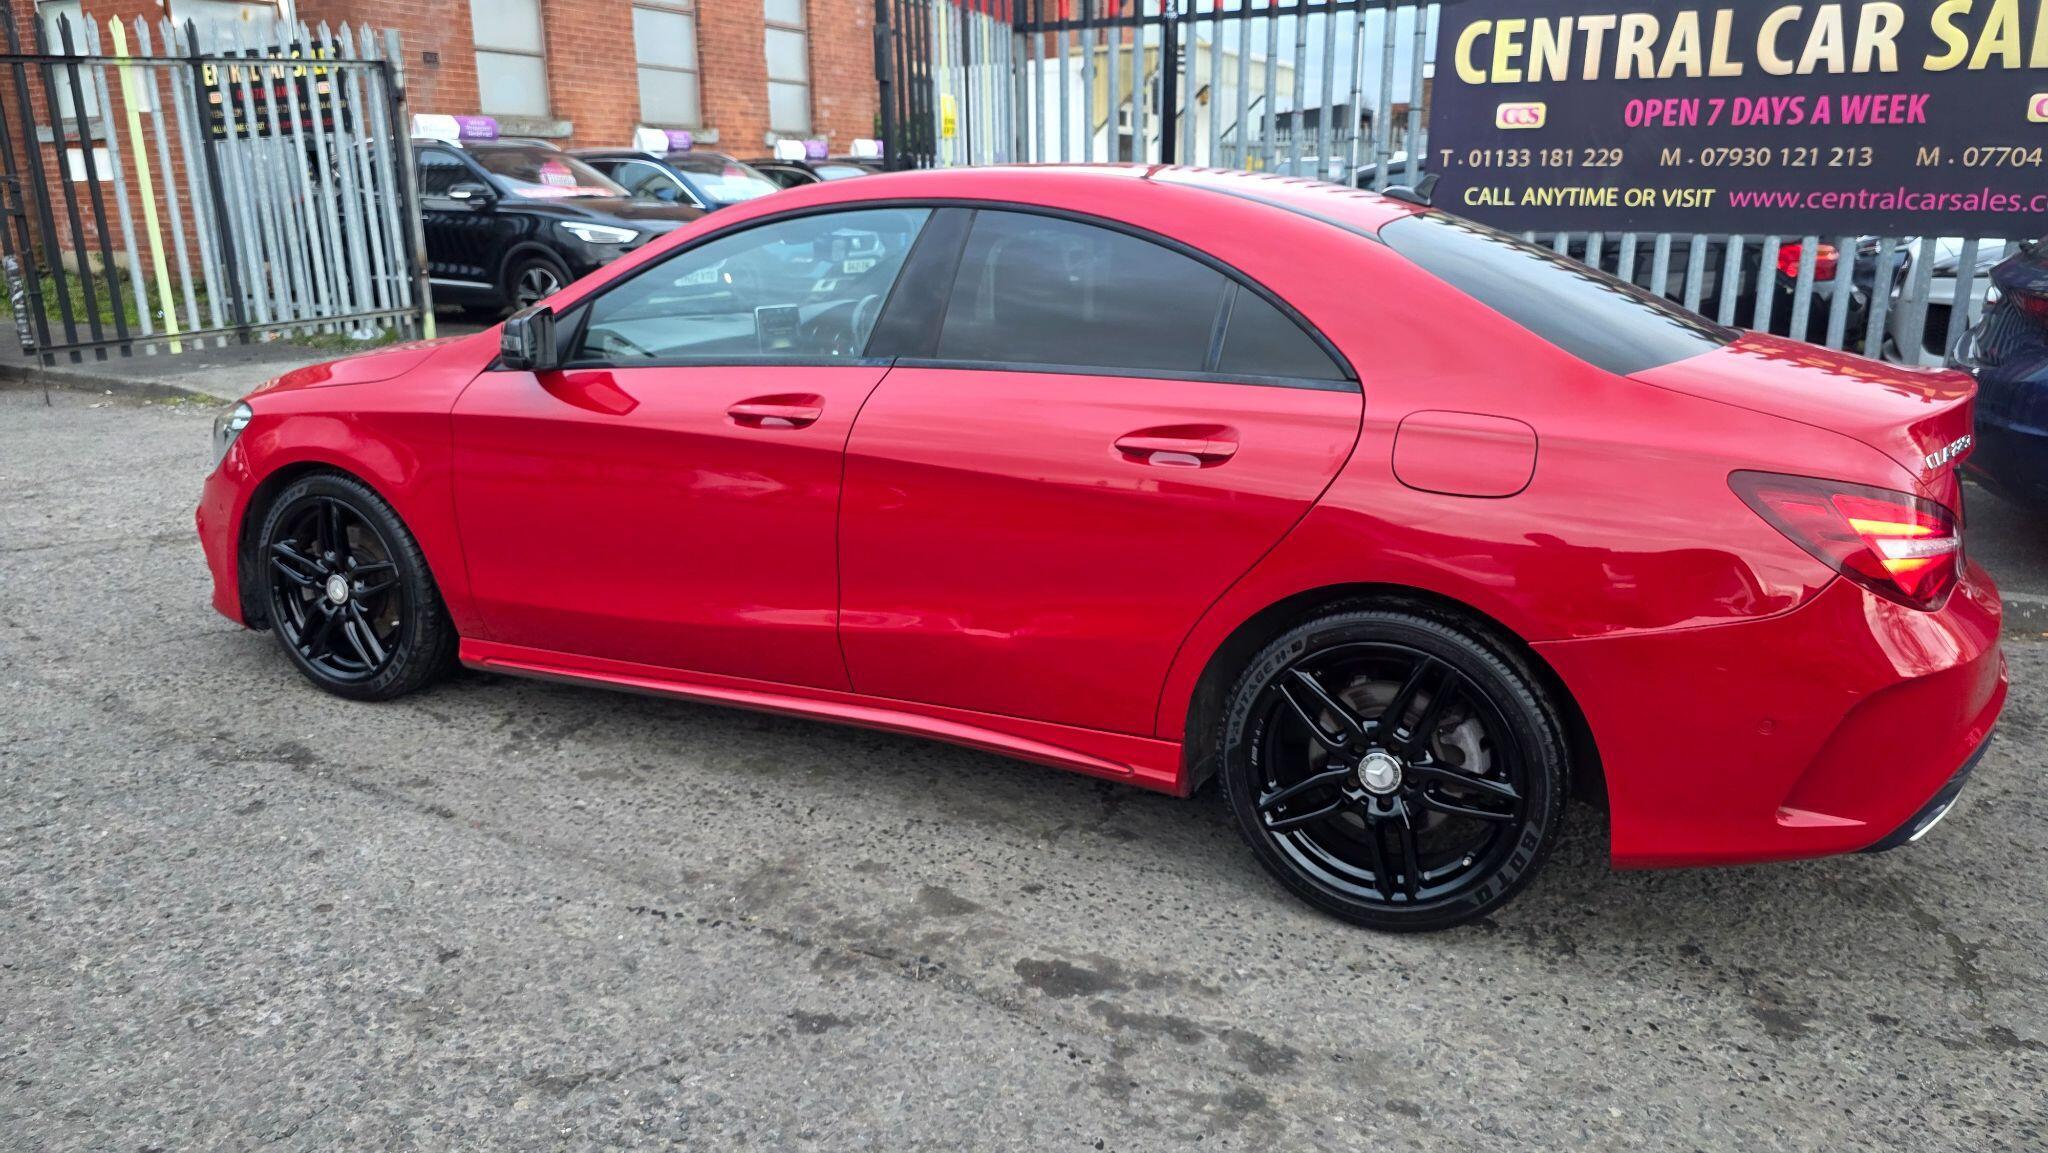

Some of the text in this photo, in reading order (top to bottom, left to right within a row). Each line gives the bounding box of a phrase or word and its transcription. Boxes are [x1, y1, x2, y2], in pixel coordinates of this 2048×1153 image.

[1454, 8, 1745, 85] CENTRAL
[1756, 0, 1905, 80] CAR
[1624, 92, 1931, 128] OPEN 7 DAYS A WEEK
[1468, 148, 1532, 168] 01133
[1539, 148, 1575, 168] 181
[1581, 147, 1624, 168] 229
[1700, 147, 1773, 167] 07930
[1780, 146, 1819, 167] 121
[1827, 146, 1874, 167] 213
[1962, 146, 2043, 168] 07704
[1463, 186, 1516, 206] CALL
[1520, 186, 1620, 207] ANYTIME
[1624, 187, 1657, 208] OR
[1661, 188, 1717, 208] VISIT
